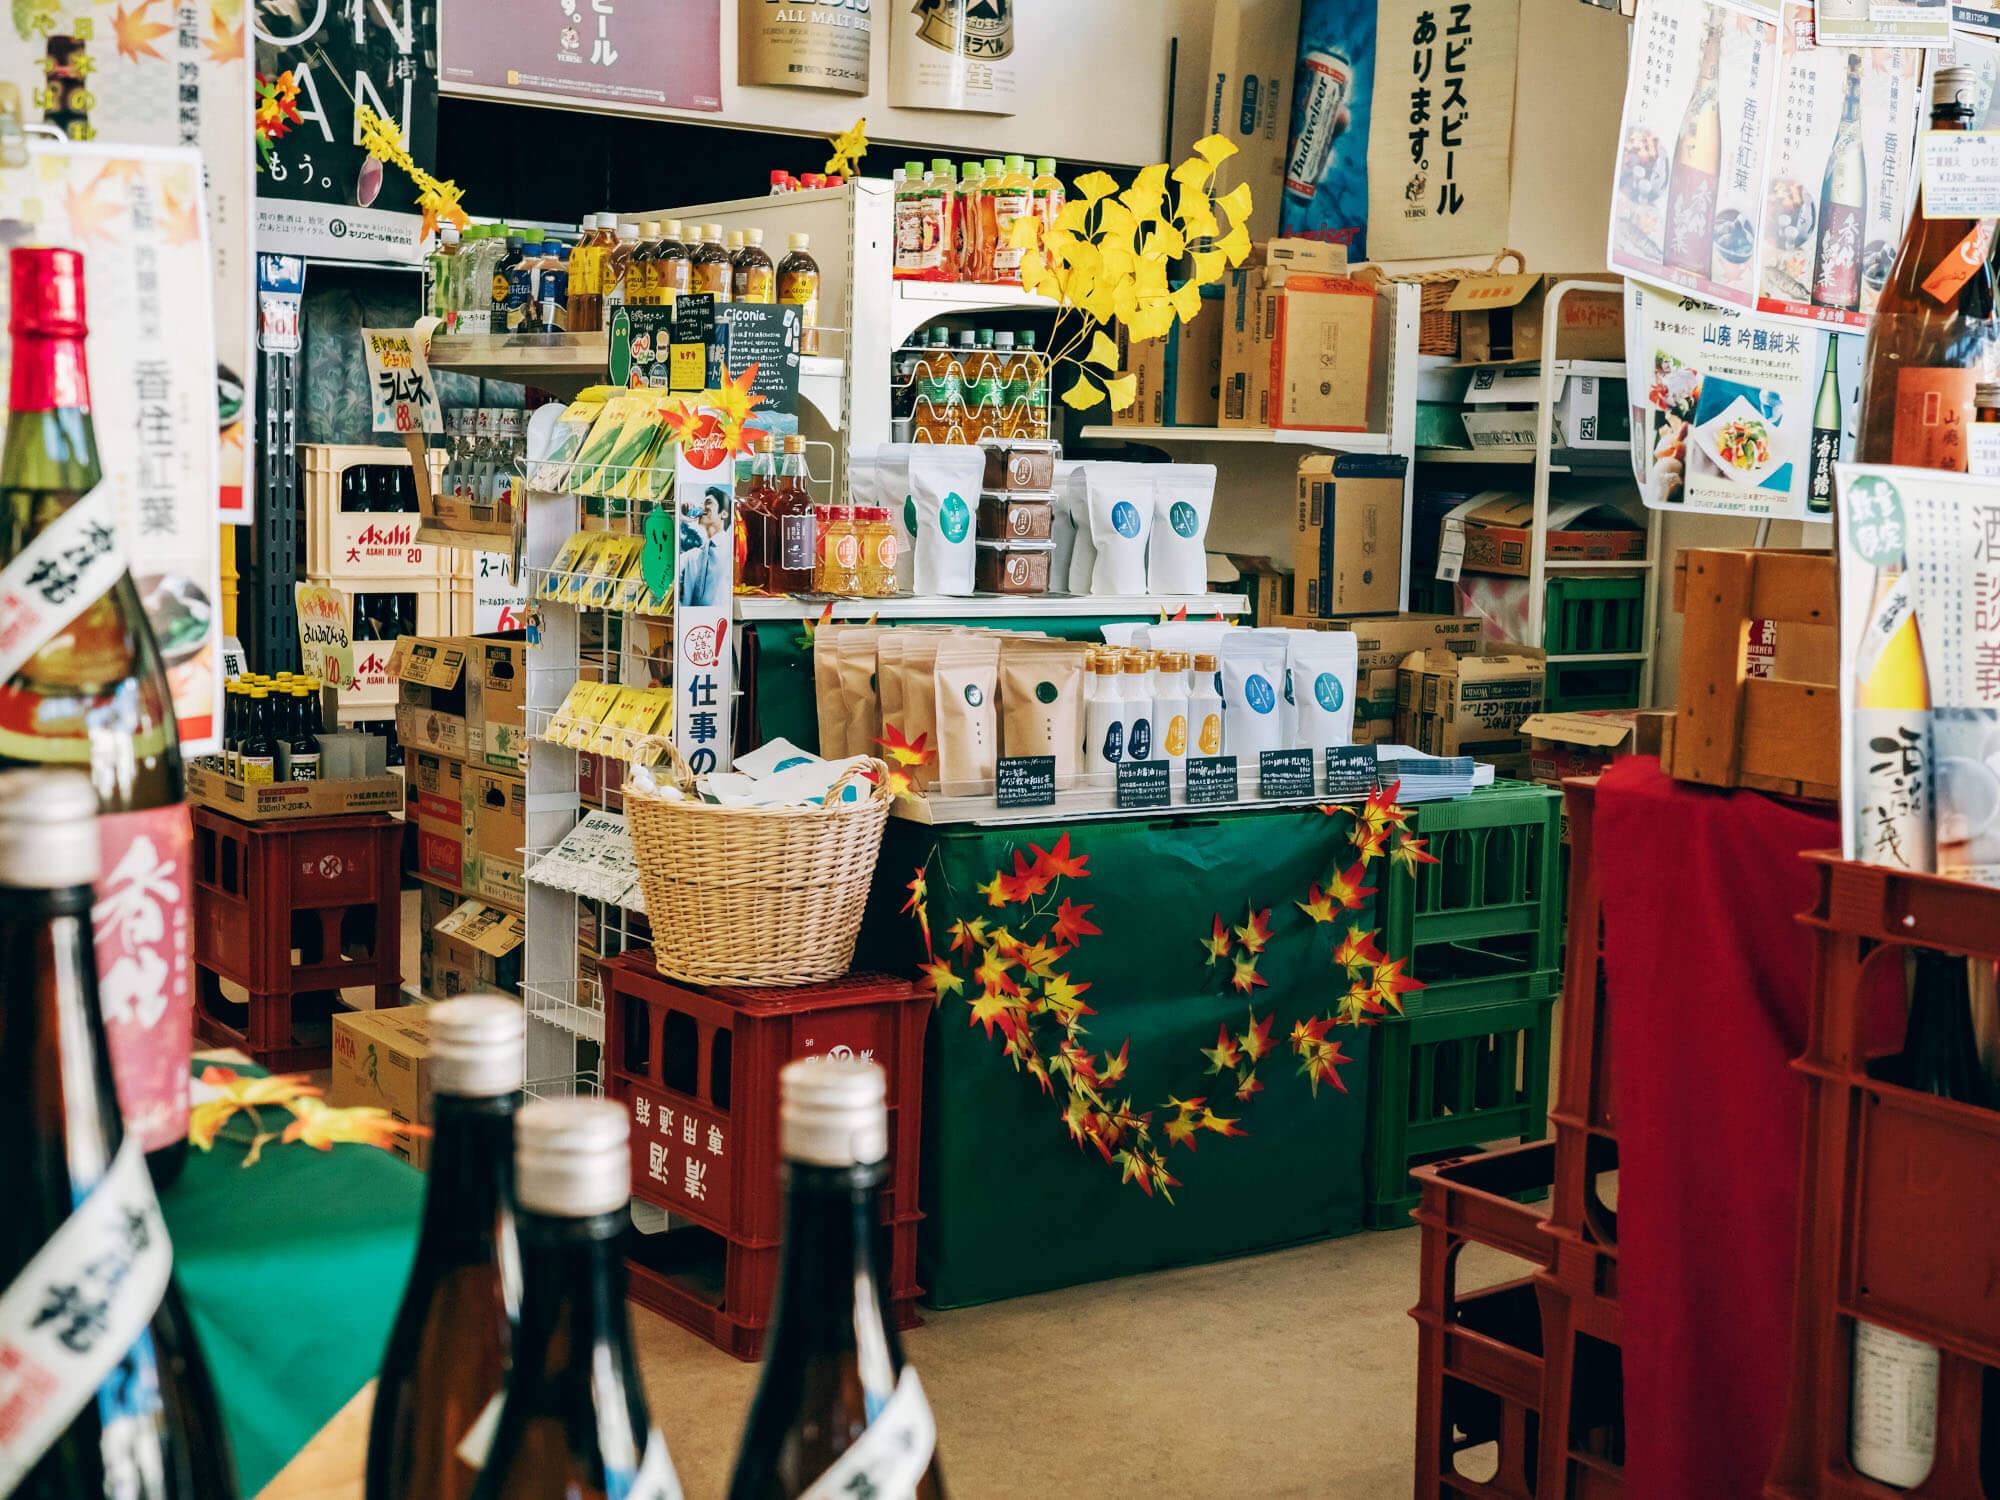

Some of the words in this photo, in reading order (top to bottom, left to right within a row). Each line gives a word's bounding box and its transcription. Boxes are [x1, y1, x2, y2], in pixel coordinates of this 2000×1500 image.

[775, 9, 806, 23] ALL
[811, 11, 850, 27] MALT
[1211, 73, 1226, 135] Panasoni
[1408, 10, 1437, 170] あります。
[1291, 77, 1328, 180] Budweiser
[269, 151, 332, 189] もう。
[349, 230, 413, 245] キリンビール株式会社
[723, 308, 767, 321] Ciconia
[1703, 322, 1732, 348] 山廃
[1737, 328, 1800, 354] 吟醸純米
[379, 367, 431, 407] ラムネ
[358, 524, 411, 546] Asahi
[346, 547, 361, 563] 大
[366, 548, 385, 557] ASAHI
[407, 548, 422, 564] 20
[690, 629, 711, 643] こんな
[325, 655, 340, 685] 120
[366, 676, 385, 685] ASAHI
[688, 674, 718, 776] 仕事の
[334, 1031, 356, 1060] HATA
[649, 1141, 707, 1201] 清酒
